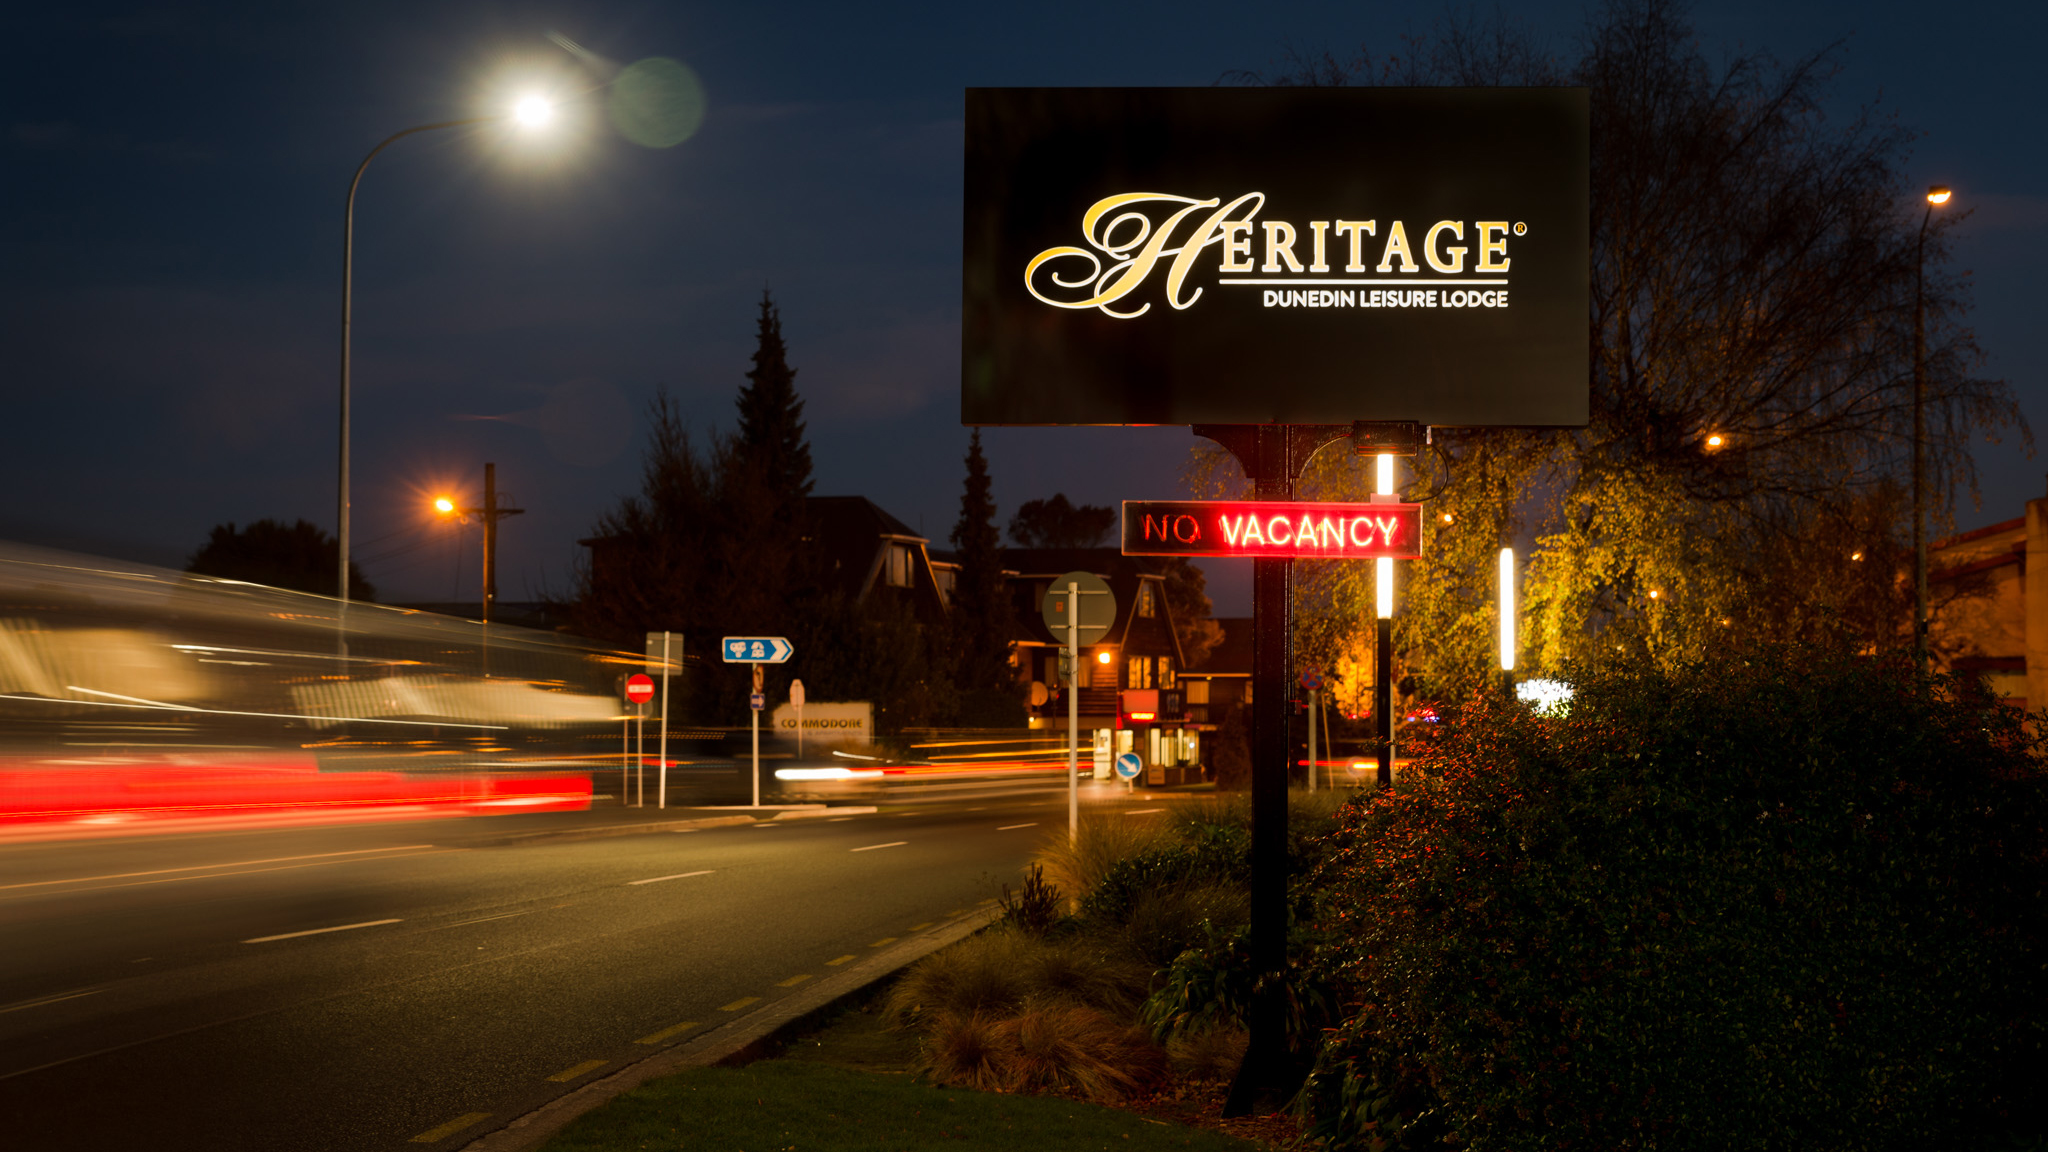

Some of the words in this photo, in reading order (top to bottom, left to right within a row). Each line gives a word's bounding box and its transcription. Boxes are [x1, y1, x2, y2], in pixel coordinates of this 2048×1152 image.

[1263, 290, 1356, 308] DUNEDIN
[1359, 290, 1438, 308] LEISURE
[1441, 290, 1509, 308] LODGE
[1142, 514, 1201, 544] NO
[1220, 514, 1398, 547] VACANCY
